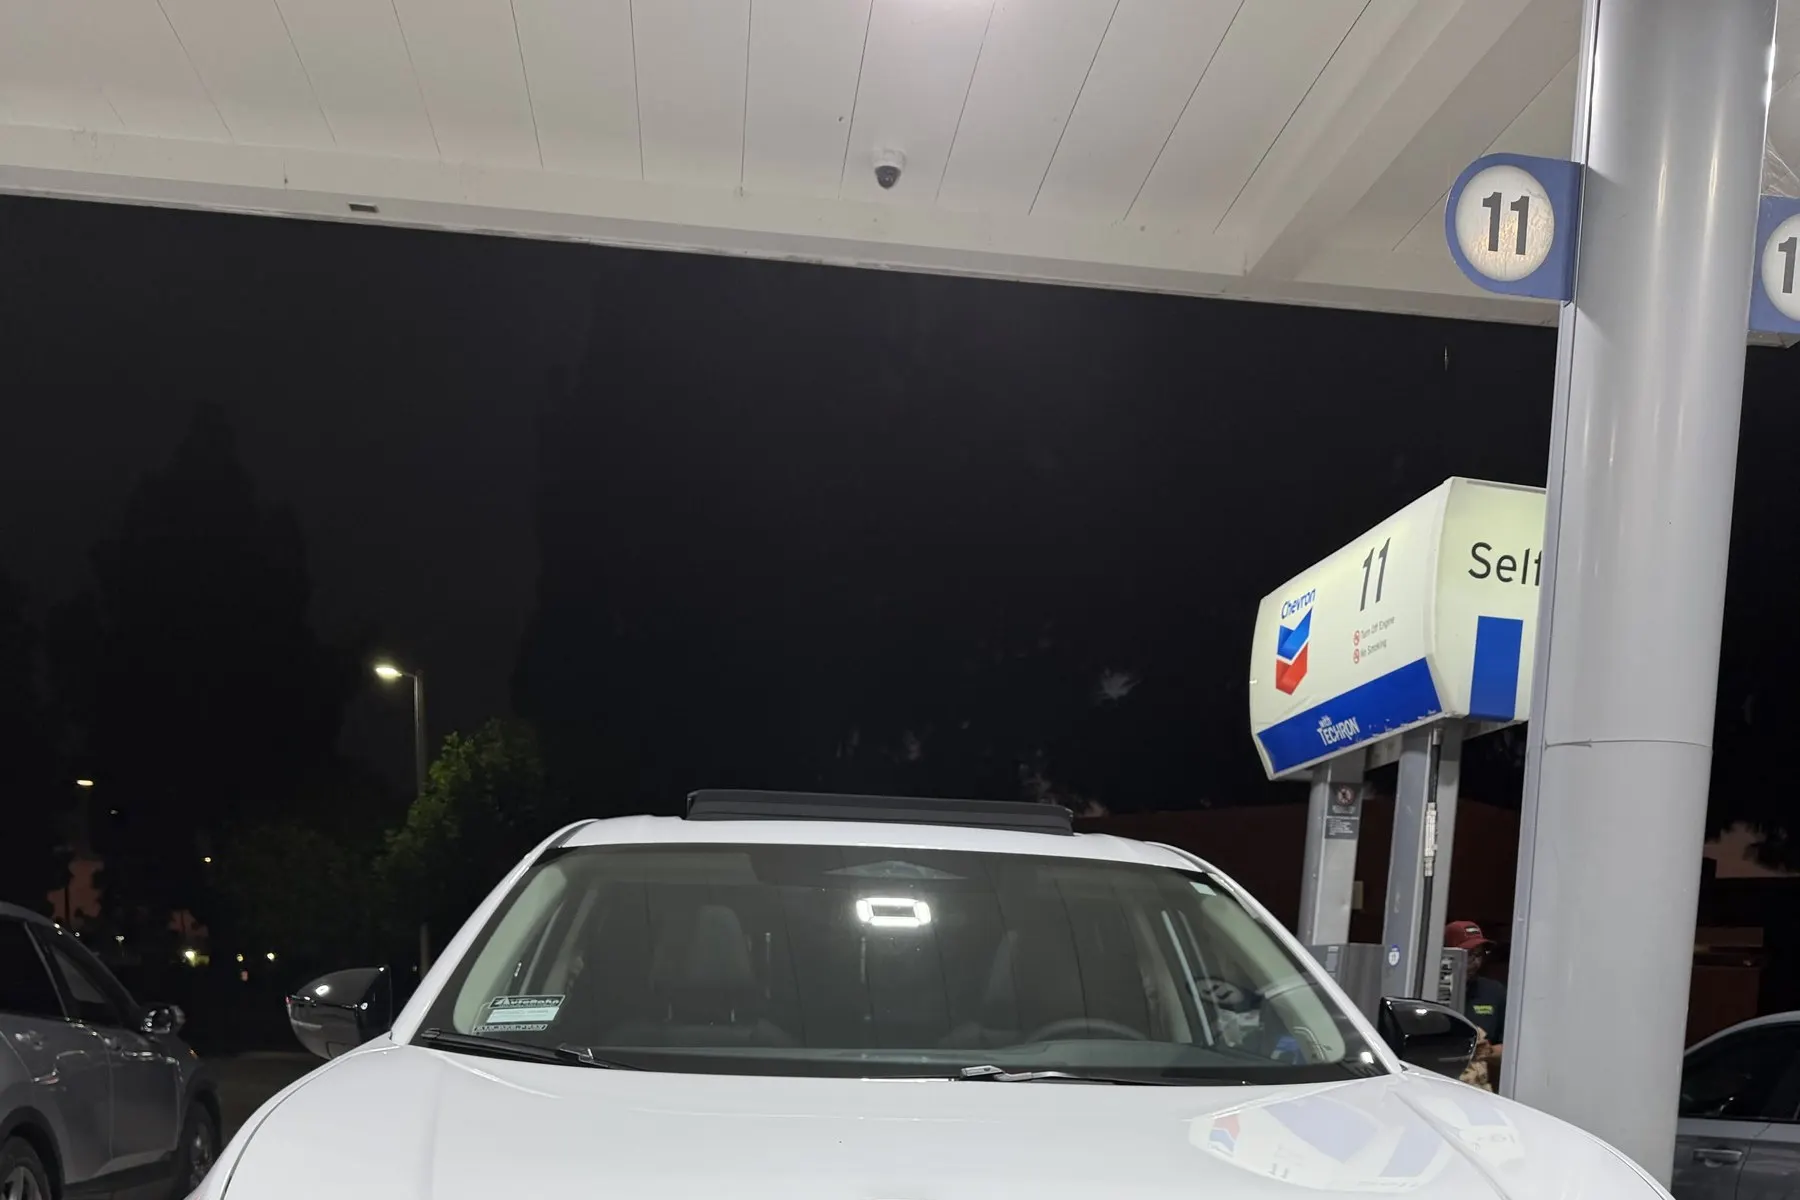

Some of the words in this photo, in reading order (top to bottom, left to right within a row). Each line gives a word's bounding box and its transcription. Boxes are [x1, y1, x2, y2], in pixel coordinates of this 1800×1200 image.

[1482, 191, 1530, 256] 11
[1359, 537, 1391, 612] 11
[1467, 541, 1543, 587] Self
[1281, 588, 1316, 620] Chevron
[1367, 639, 1387, 656] Smoking
[1316, 716, 1361, 746] TECHRON
